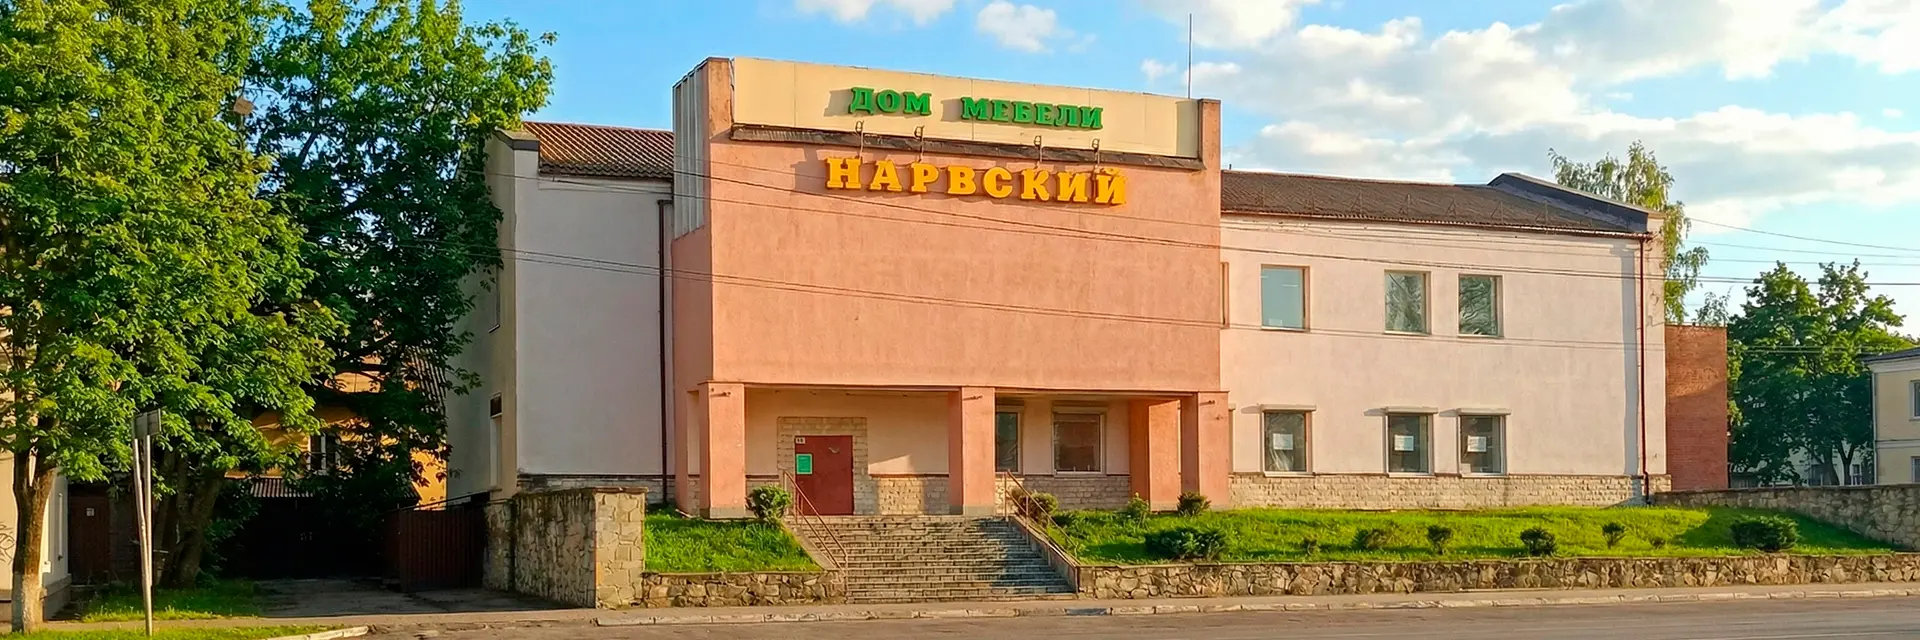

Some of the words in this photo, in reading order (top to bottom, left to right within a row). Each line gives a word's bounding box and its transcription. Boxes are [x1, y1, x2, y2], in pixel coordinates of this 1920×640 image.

[850, 87, 932, 115] ДОМ
[962, 97, 1103, 129] МЕБЕЛИ
[826, 157, 1127, 204] НАРВСКИЙ
